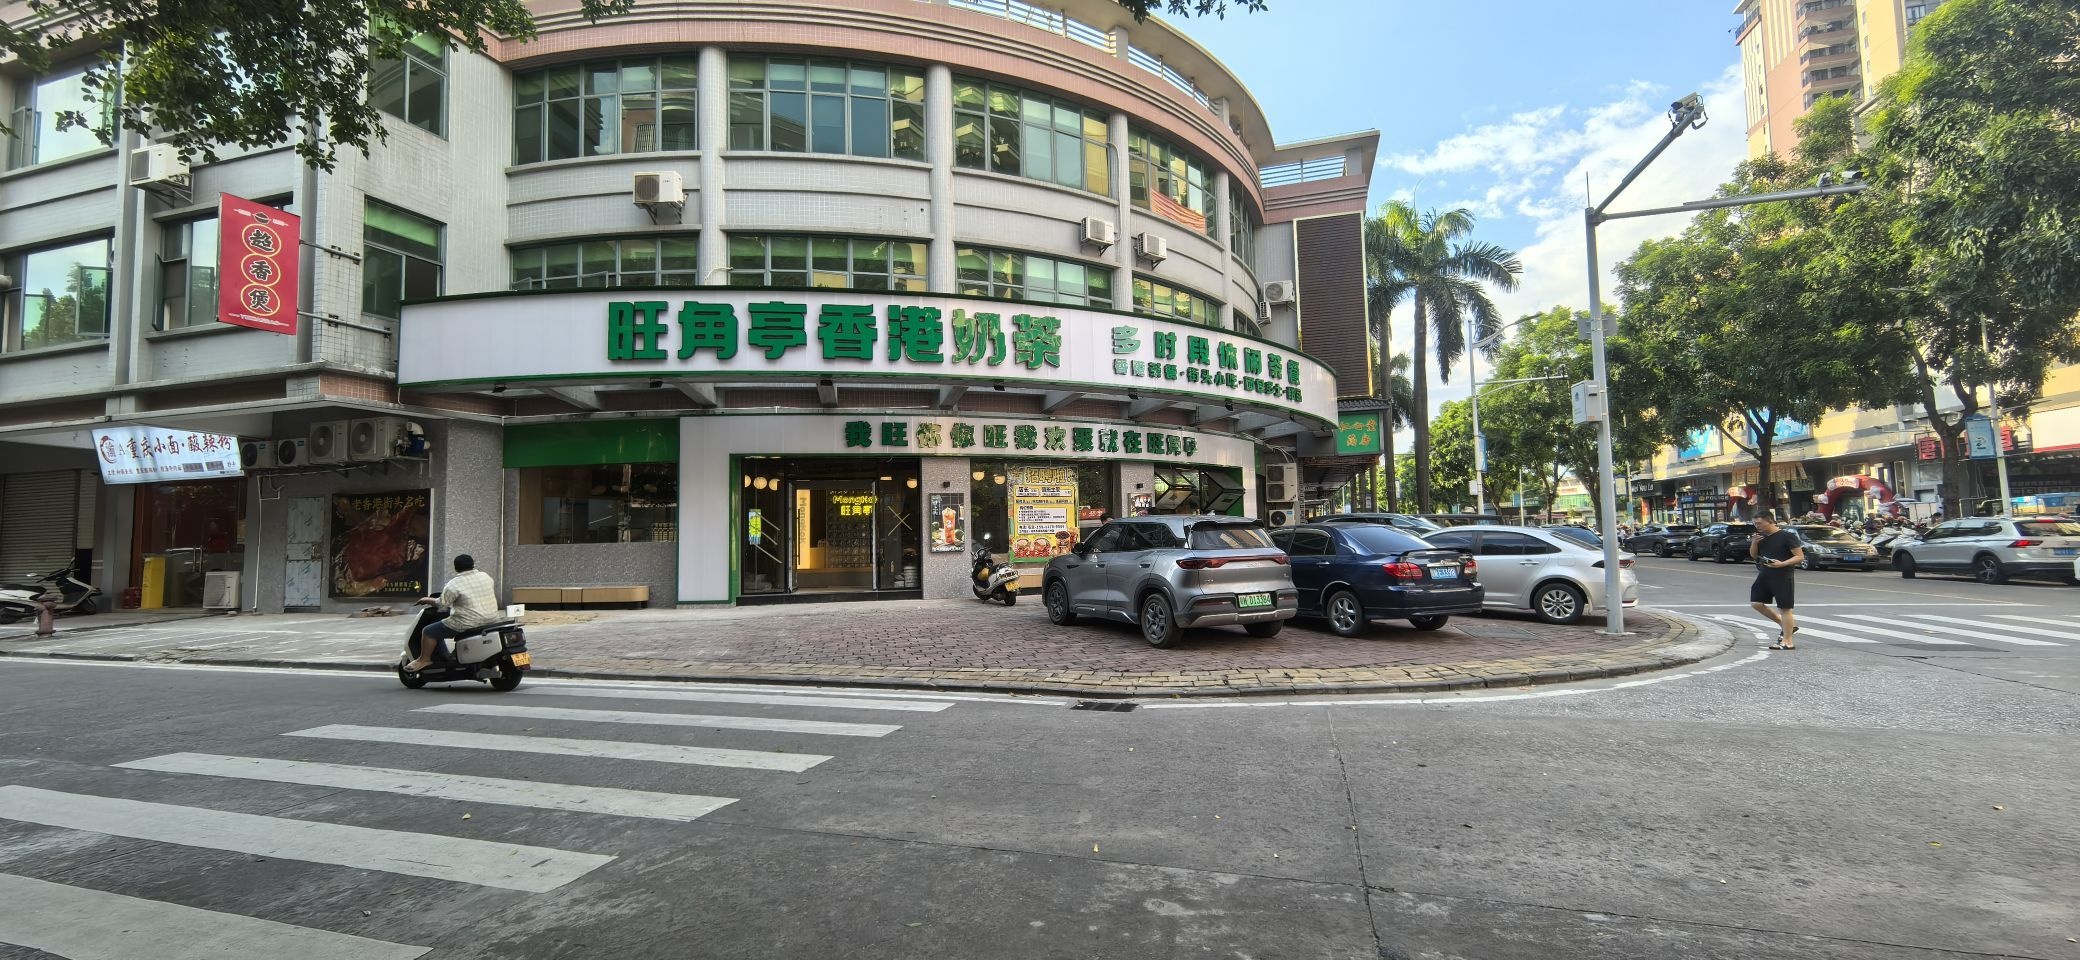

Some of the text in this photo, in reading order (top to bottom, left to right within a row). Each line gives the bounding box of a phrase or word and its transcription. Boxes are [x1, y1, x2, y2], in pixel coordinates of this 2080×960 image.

[607, 300, 1063, 370] 旺角亭香港奶茶
[1113, 325, 1301, 386] 多时段休闲茶餐
